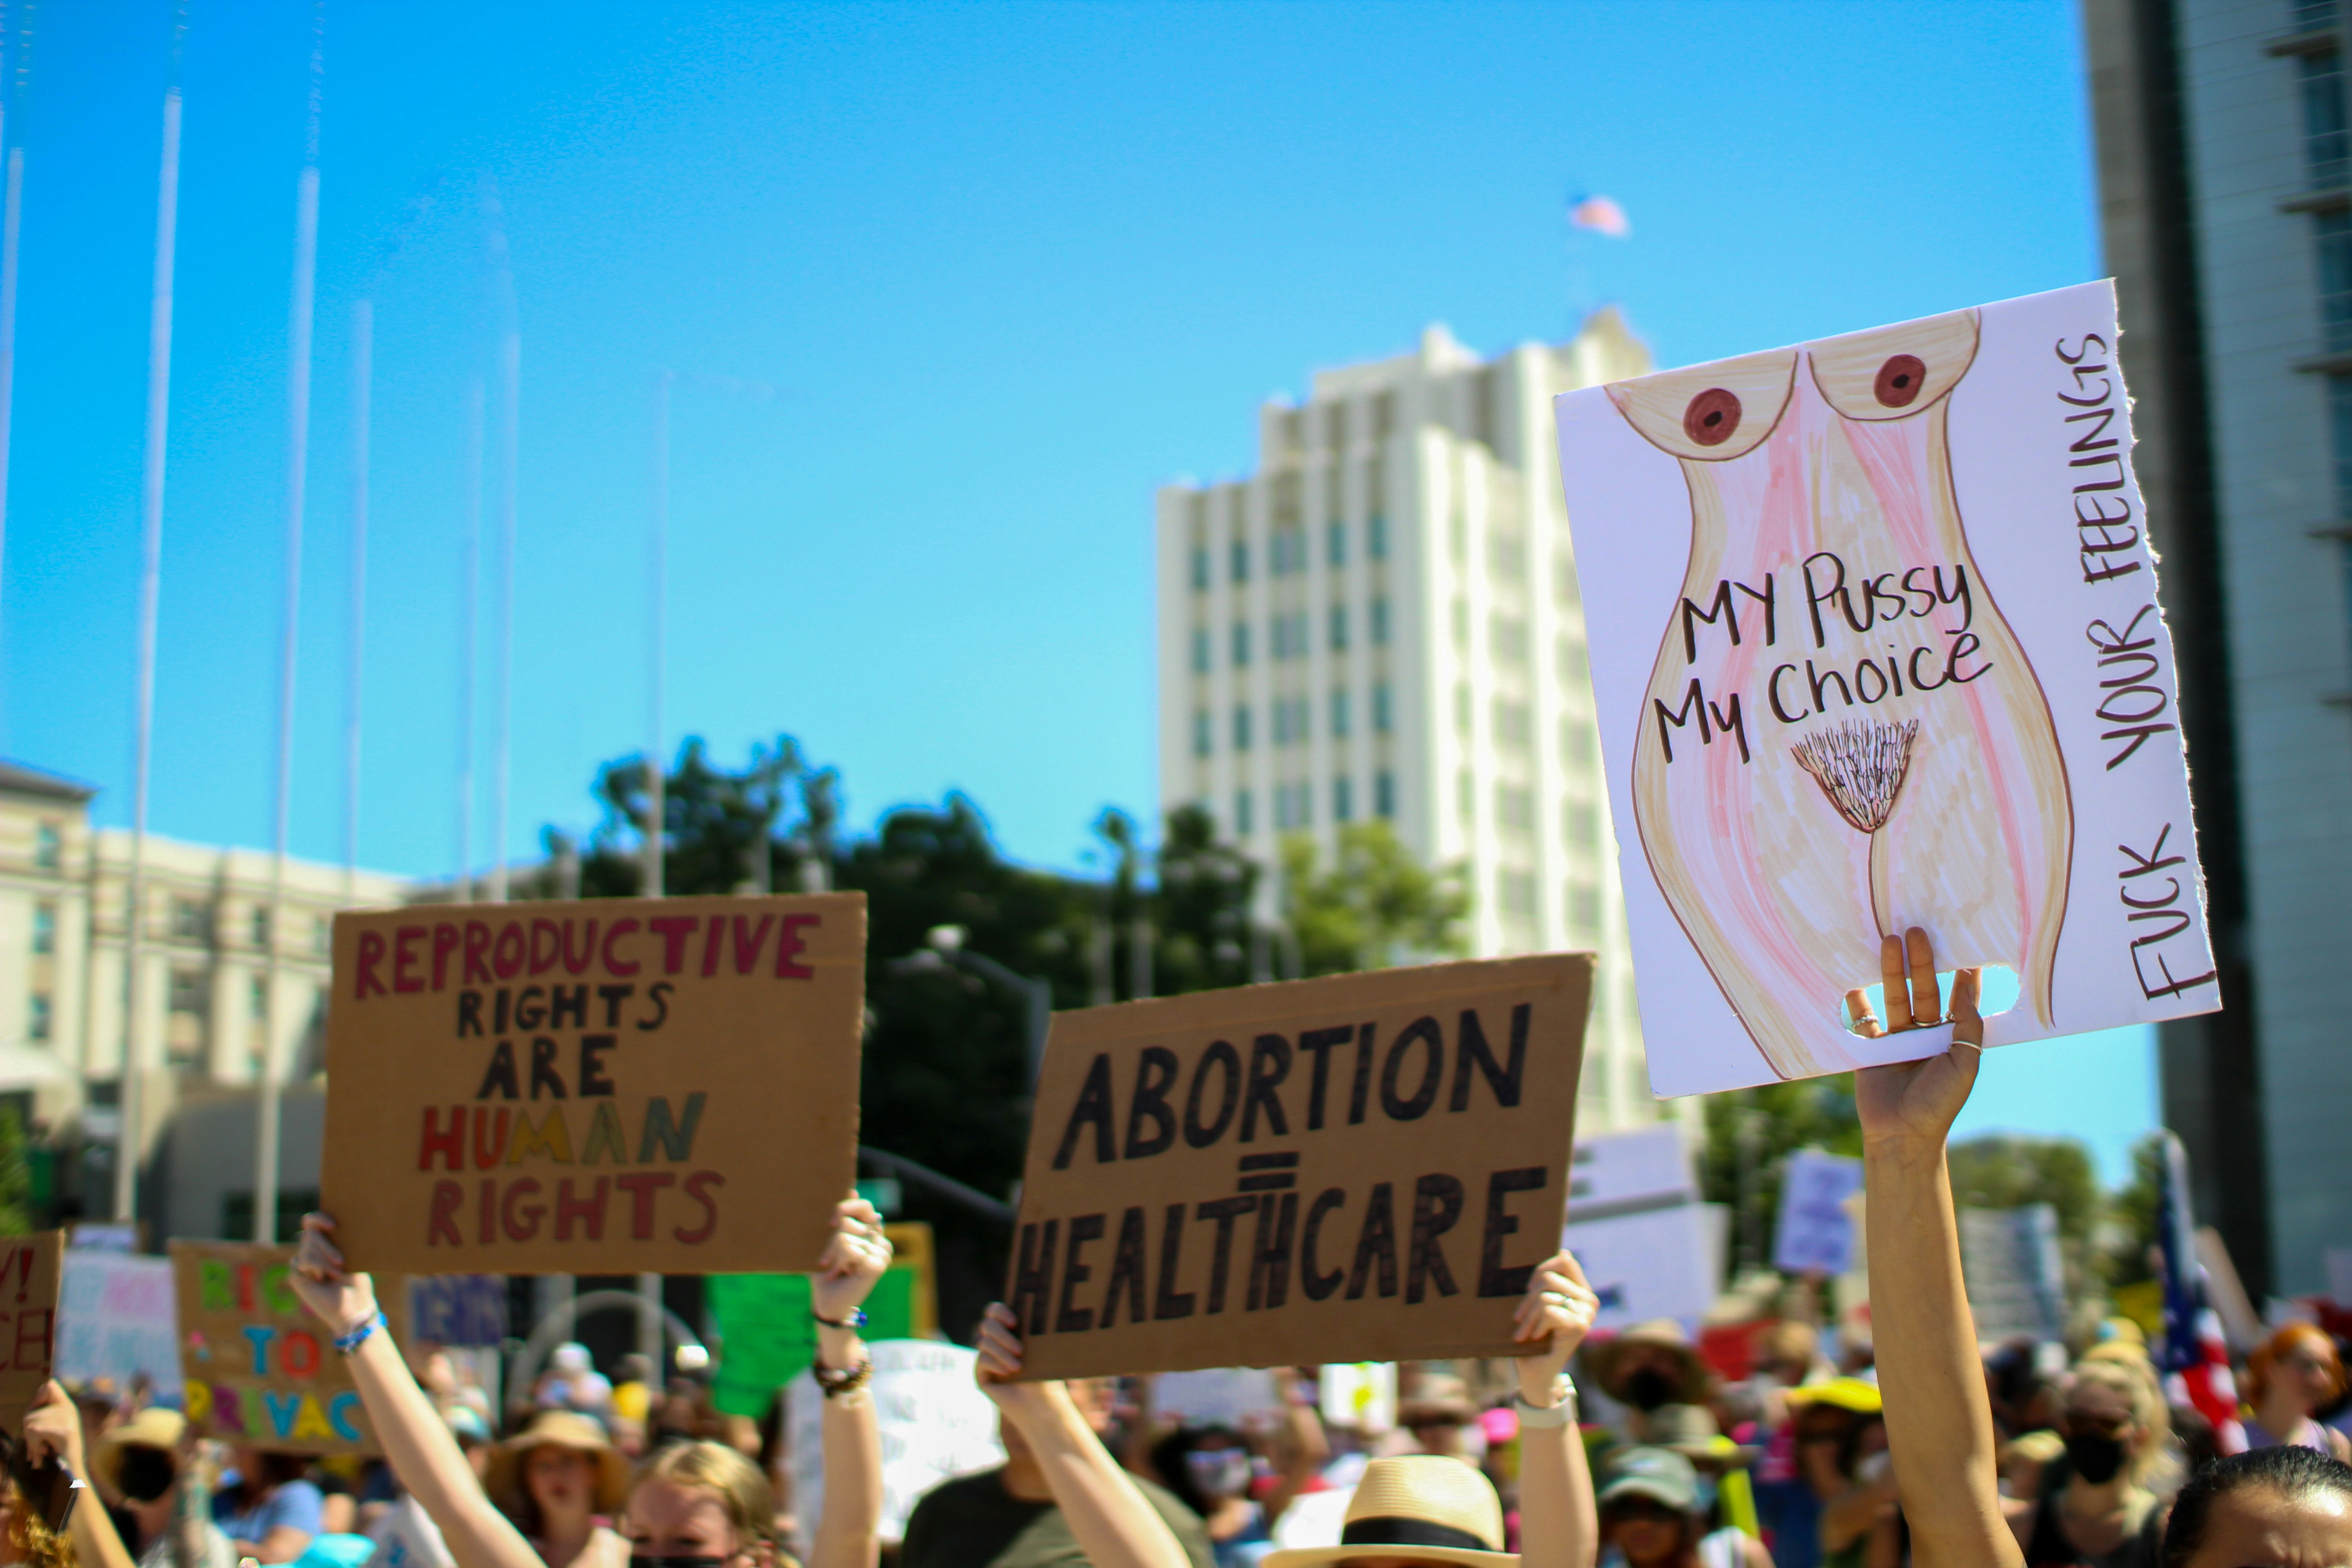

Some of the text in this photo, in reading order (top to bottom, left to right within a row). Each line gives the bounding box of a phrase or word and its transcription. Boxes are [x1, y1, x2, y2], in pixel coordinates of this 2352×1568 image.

[1802, 552, 1973, 648] Pussy
[1654, 632, 1994, 764] My Choice
[2055, 333, 2218, 1001] FUCK YOUR FEELINGS
[356, 914, 820, 1000] REPRODUCTIVE
[457, 982, 674, 1038] RIGHTS
[476, 1034, 616, 1100] ARE
[1051, 1003, 1532, 1171] ABORTION
[418, 1092, 707, 1171] HUMAN
[428, 1171, 726, 1247] RIGHTS
[1012, 1166, 1548, 1336] HEALTHCARE
[242, 1324, 322, 1381] TO
[184, 1377, 364, 1442] PRIVAC
